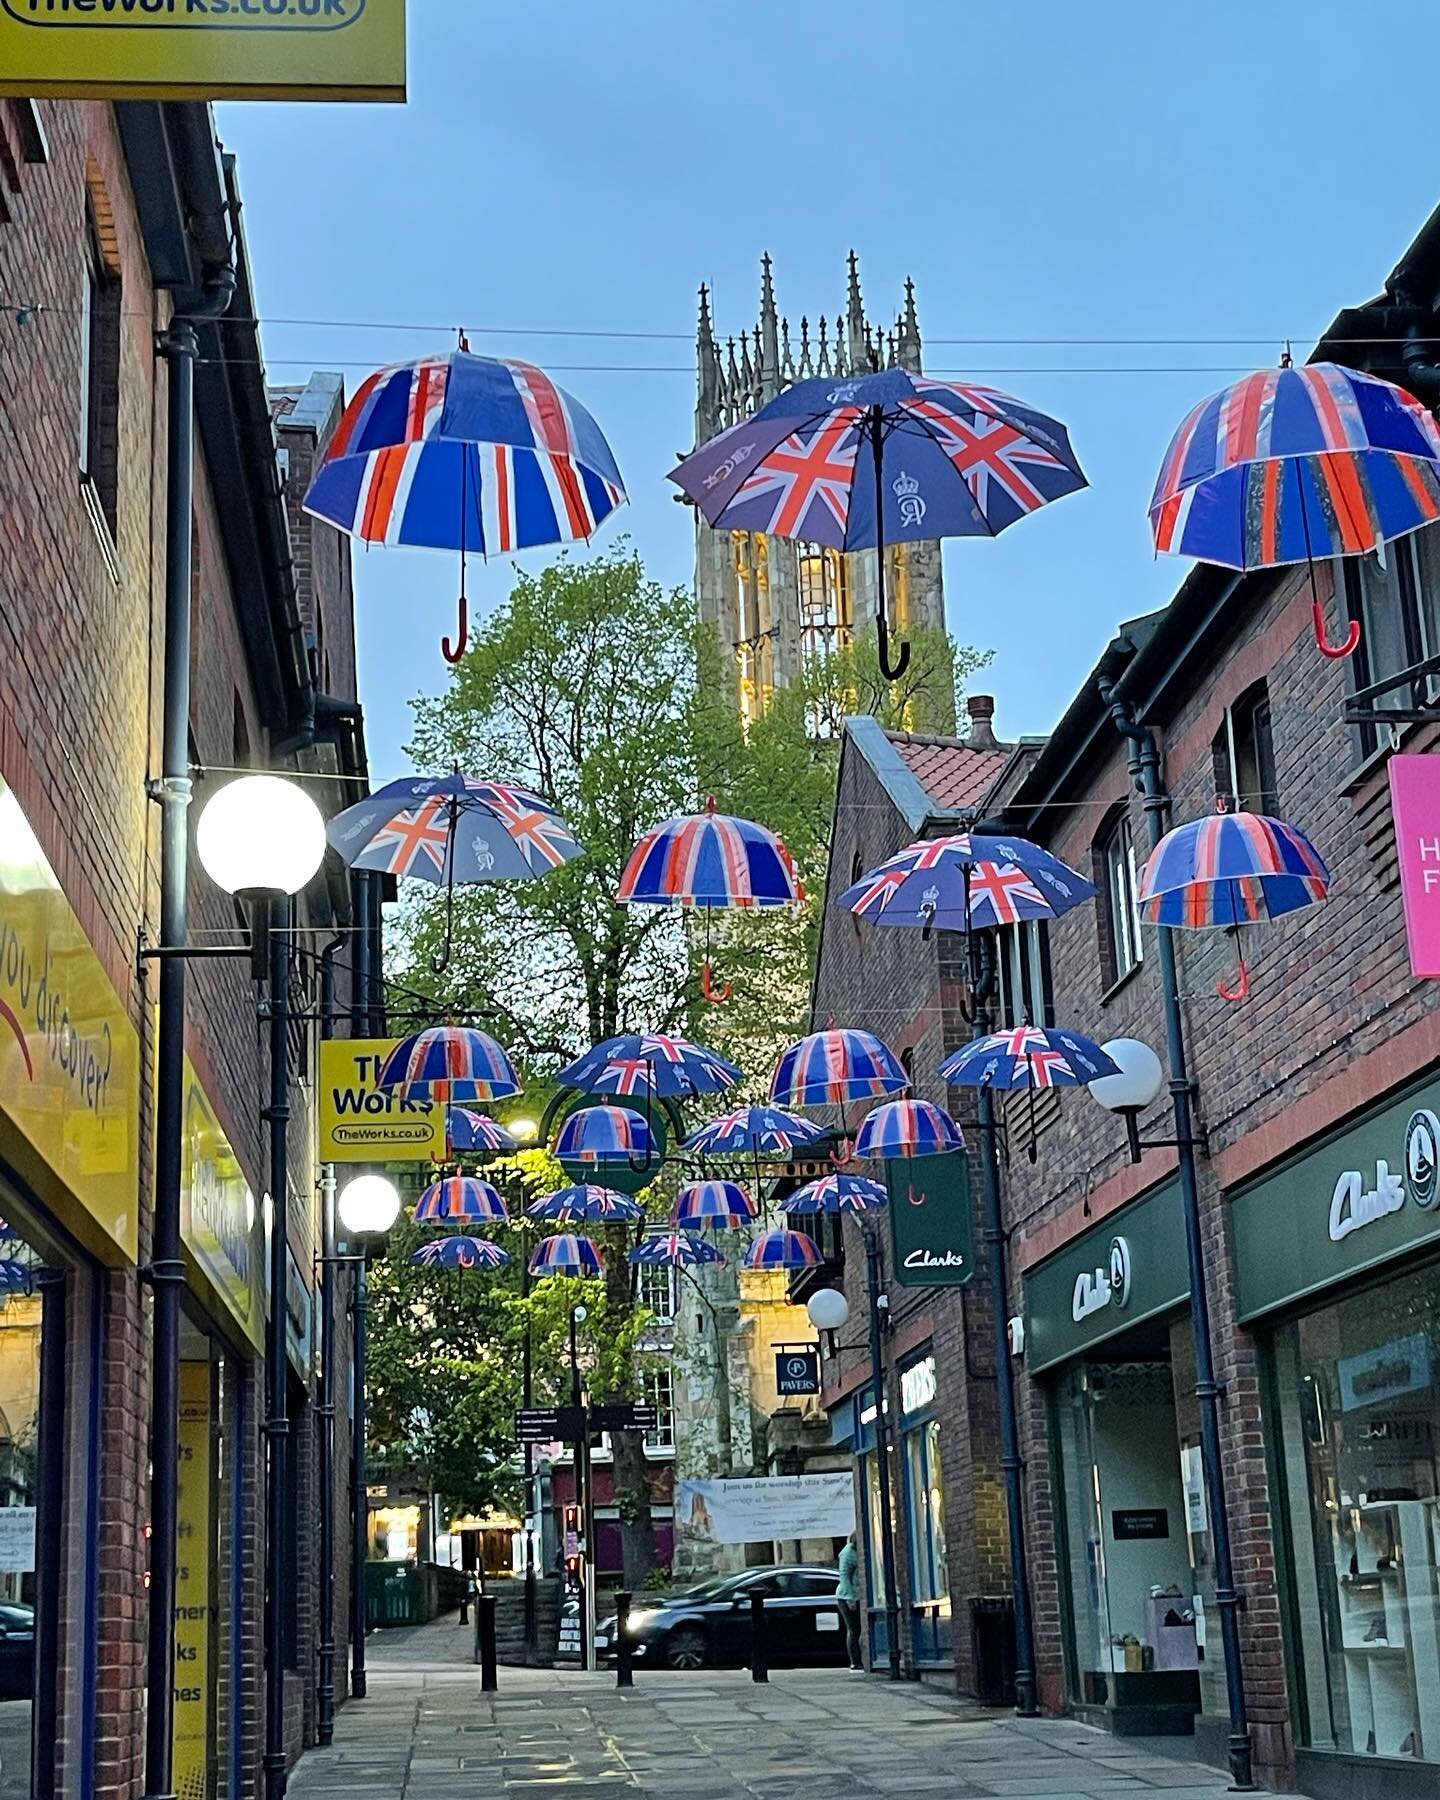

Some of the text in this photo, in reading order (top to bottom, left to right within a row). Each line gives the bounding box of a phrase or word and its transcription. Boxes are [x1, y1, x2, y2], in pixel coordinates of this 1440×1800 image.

[338, 1128, 429, 1139] TheWorks.co.uk
[904, 1249, 963, 1268] Clarks
[781, 1380, 815, 1391] PAVERS
